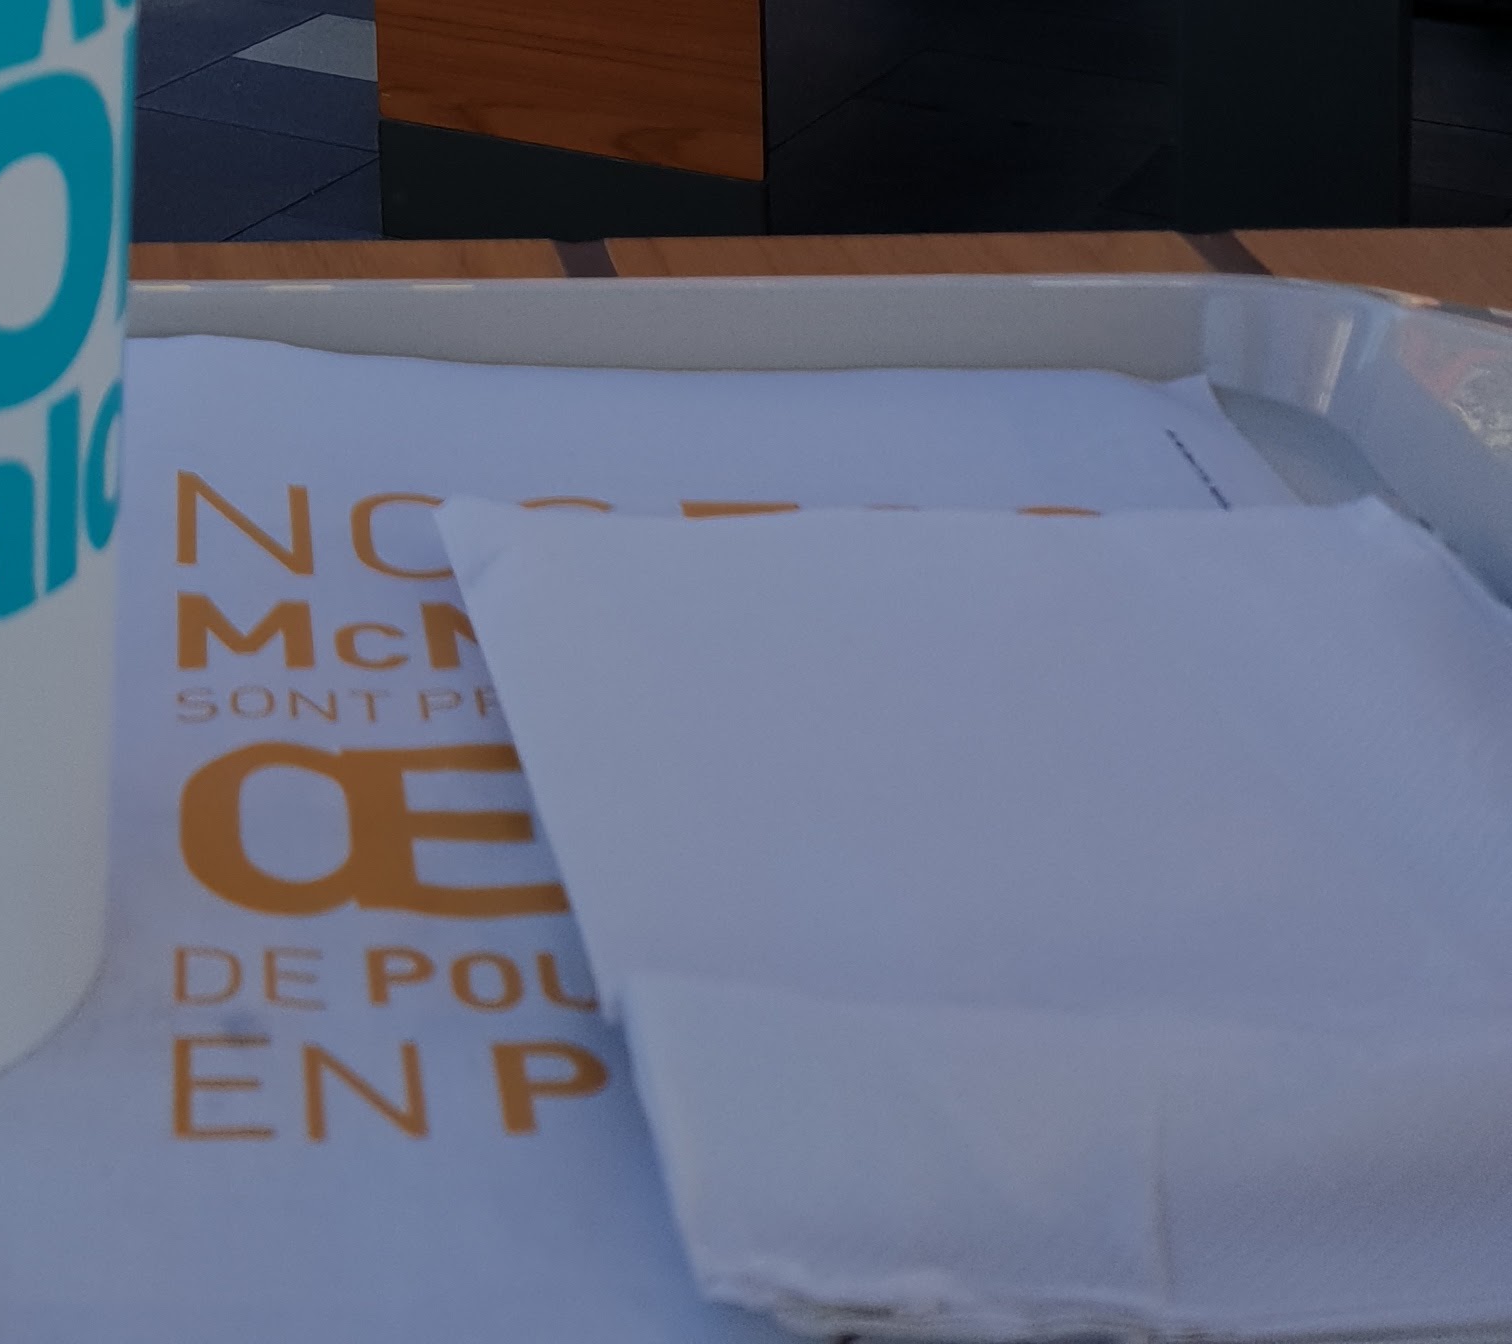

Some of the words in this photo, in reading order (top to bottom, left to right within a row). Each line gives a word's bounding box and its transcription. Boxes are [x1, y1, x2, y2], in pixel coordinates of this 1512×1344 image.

[176, 684, 390, 724] SONT
[174, 946, 326, 1012] DE
[173, 1034, 431, 1143] EN
